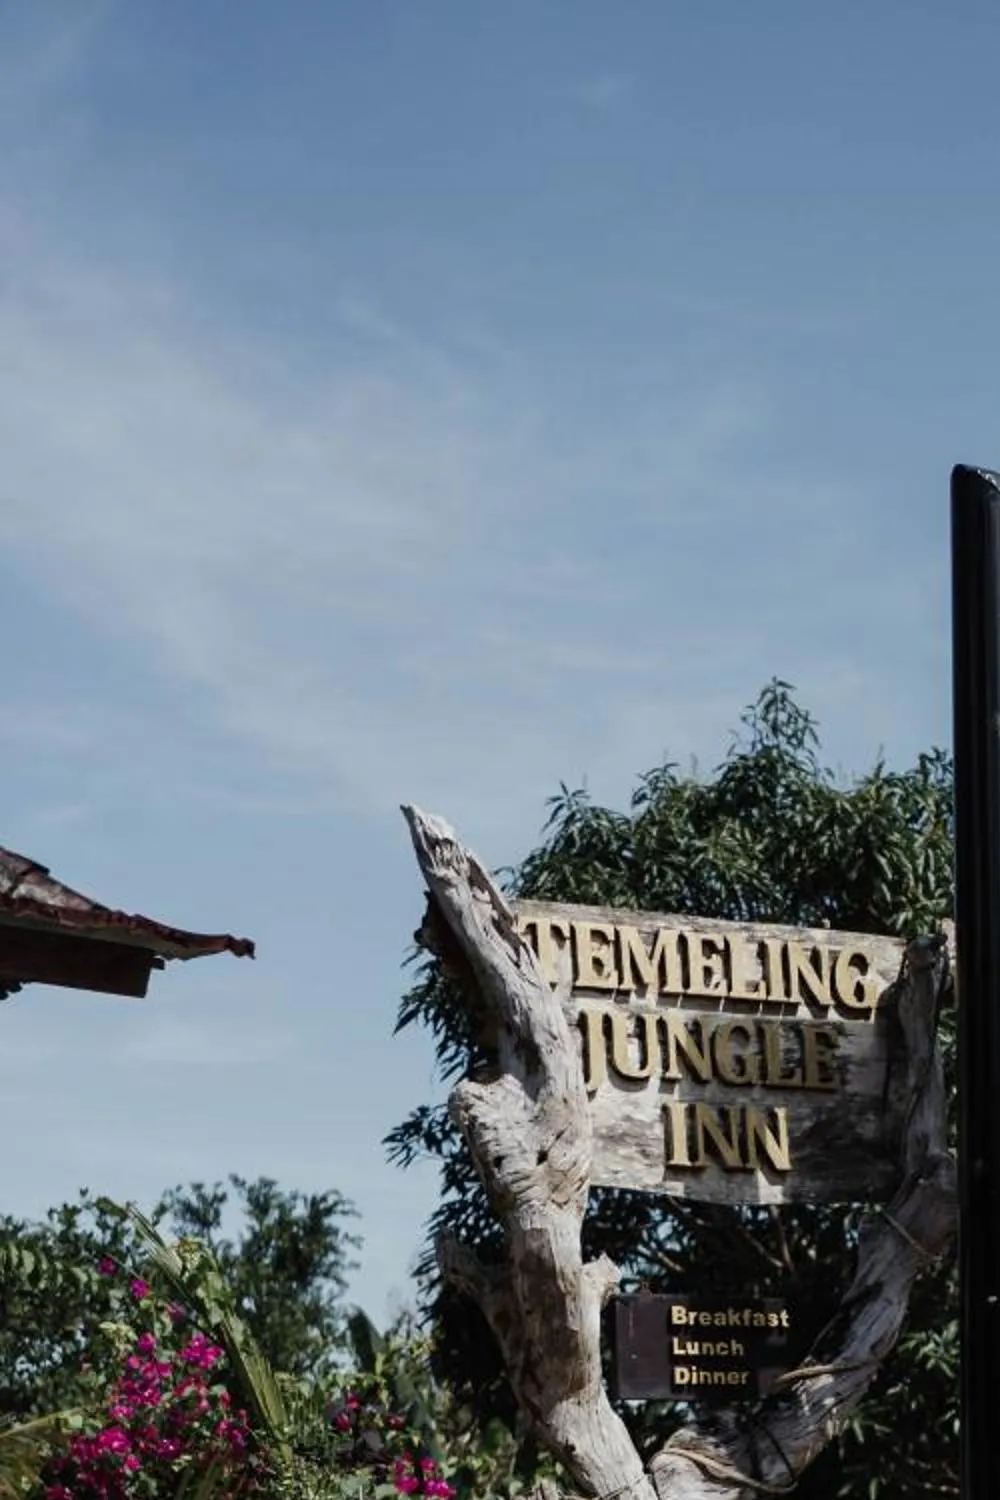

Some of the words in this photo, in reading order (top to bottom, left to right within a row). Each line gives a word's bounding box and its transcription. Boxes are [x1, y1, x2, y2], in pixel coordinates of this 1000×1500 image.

[520, 916, 884, 1012] TEMELING
[579, 1008, 841, 1093] JUNGLE
[666, 1102, 792, 1172] INN
[671, 1304, 791, 1329] Breakfast
[672, 1335, 745, 1357] Lunch
[673, 1366, 750, 1386] Dinner
